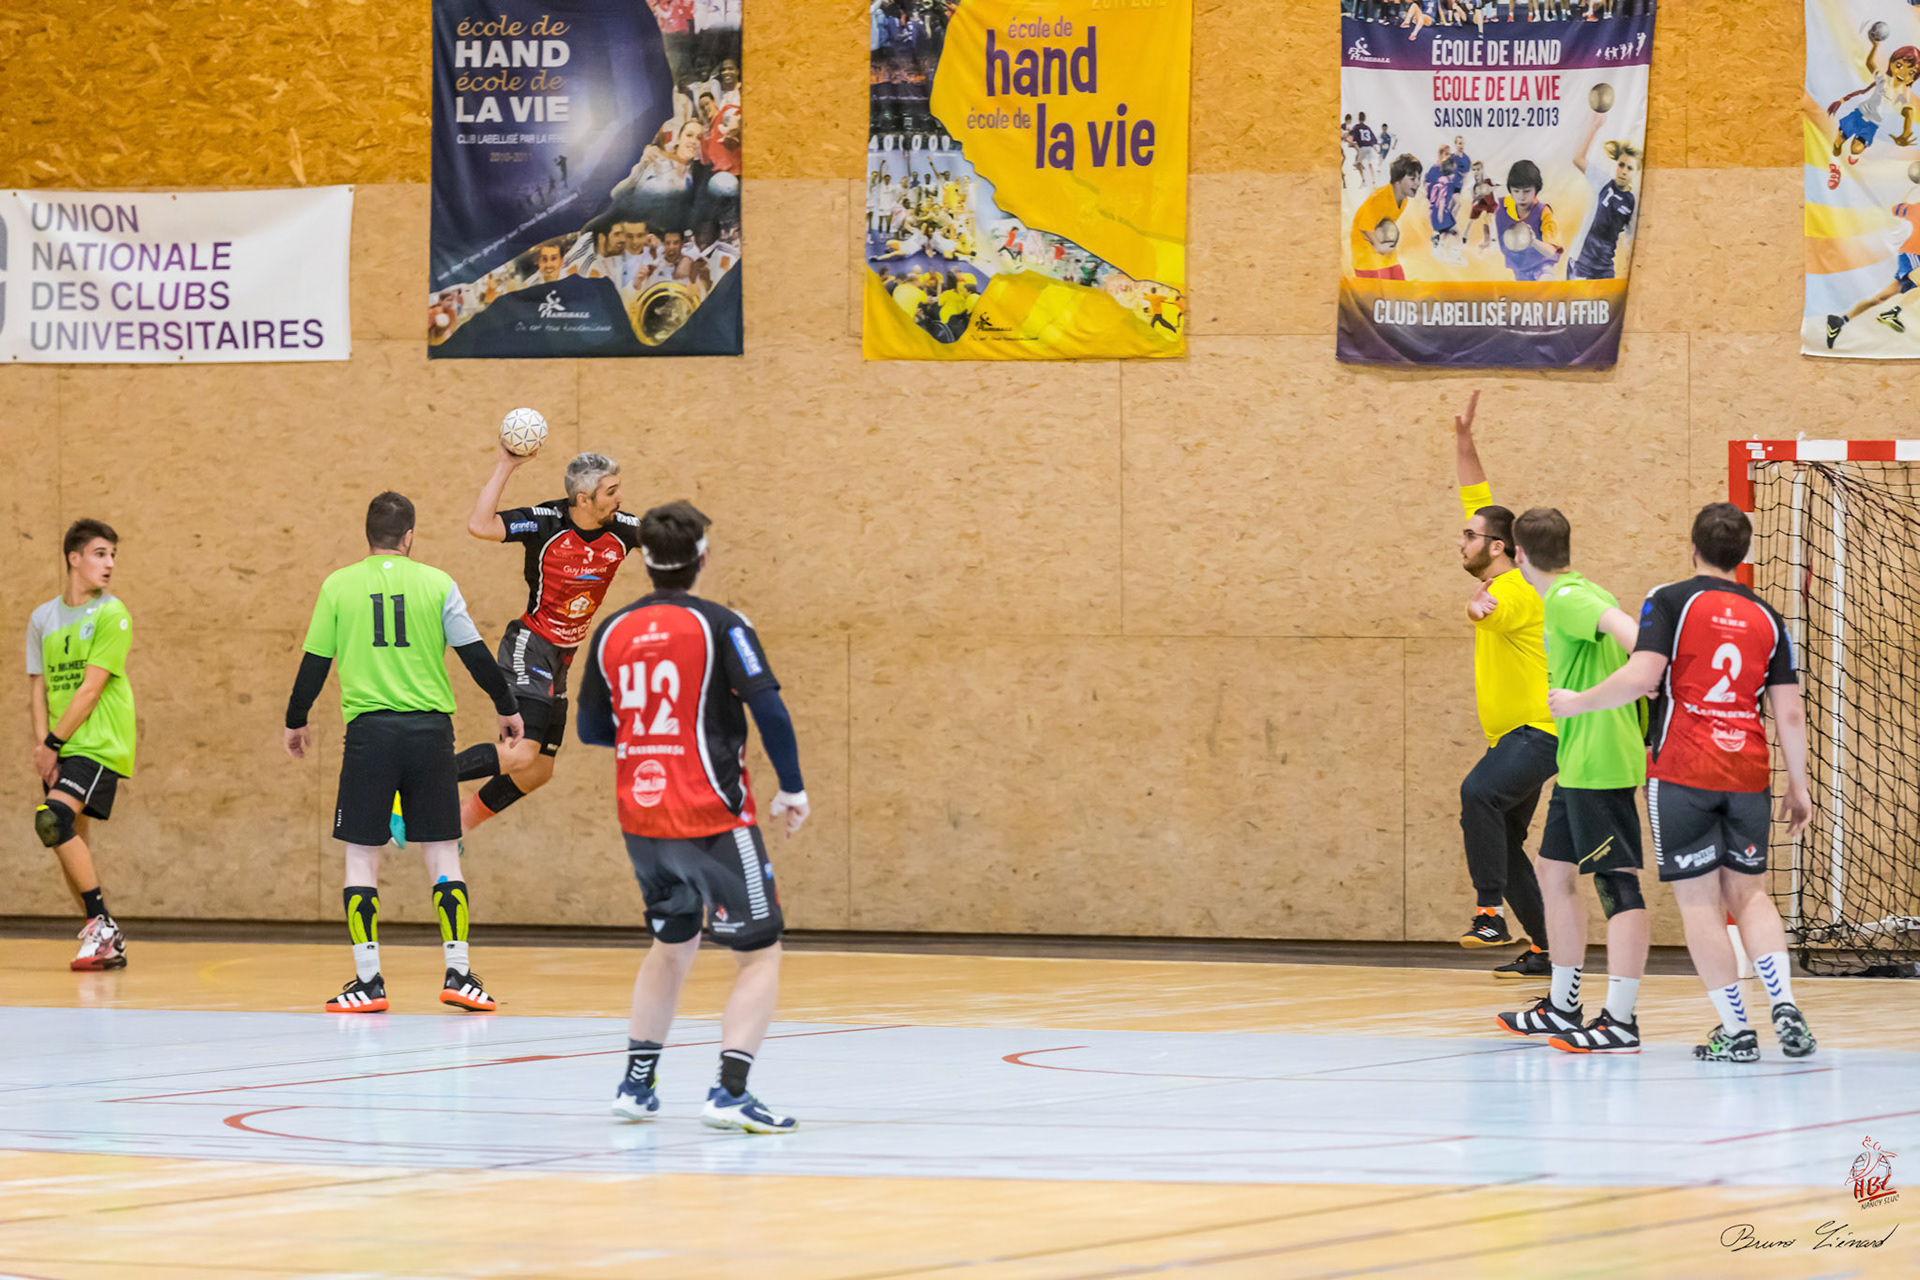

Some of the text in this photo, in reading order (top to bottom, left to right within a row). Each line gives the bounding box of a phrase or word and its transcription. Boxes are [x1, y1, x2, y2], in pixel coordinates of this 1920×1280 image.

[457, 15, 570, 36] école de
[1008, 15, 1072, 38] école de
[455, 40, 570, 68] HAND
[986, 26, 1097, 97] hand
[1432, 34, 1561, 66] ÉCOLE DE HAND
[456, 70, 566, 91] école de
[1432, 70, 1560, 102] ÉCOLE DE LA VIE
[456, 96, 569, 122] LA VIE
[1434, 107, 1559, 128] SAISON 2012-2013
[967, 103, 1155, 170] école de la vie
[1359, 129, 1371, 141] 13
[31, 203, 139, 233] UNION
[32, 242, 232, 272] NATIONALE
[31, 281, 230, 311] DES CLUBS
[1373, 298, 1609, 326] CLUB LABELLISÉ PAR LA FFHB
[30, 319, 324, 351] UNIVERSITAIRES
[563, 565, 579, 575] Guy
[369, 593, 411, 647] 11
[1703, 642, 1742, 702] 2
[618, 660, 680, 736] 42
